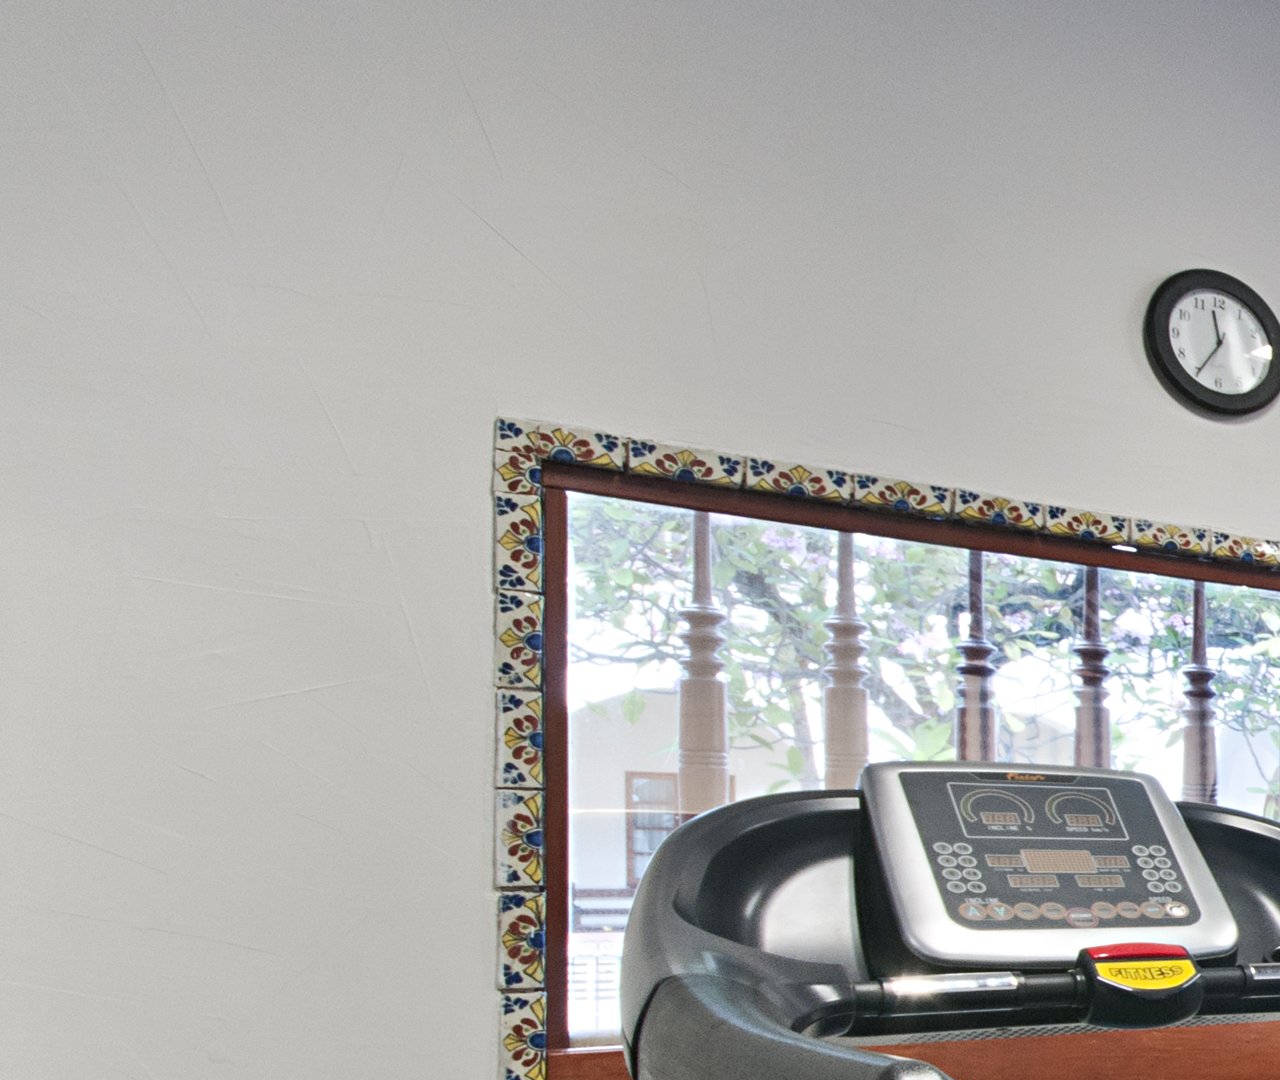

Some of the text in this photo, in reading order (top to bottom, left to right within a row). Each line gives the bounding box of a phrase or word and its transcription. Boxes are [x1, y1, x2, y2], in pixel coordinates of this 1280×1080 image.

[1193, 297, 1205, 311] 11
[1212, 297, 1226, 311] 12
[1179, 309, 1191, 322] 10
[1172, 327, 1180, 339] 9
[1178, 347, 1186, 359] 8
[1214, 377, 1223, 390] 6
[1109, 966, 1184, 981] FITNESS
